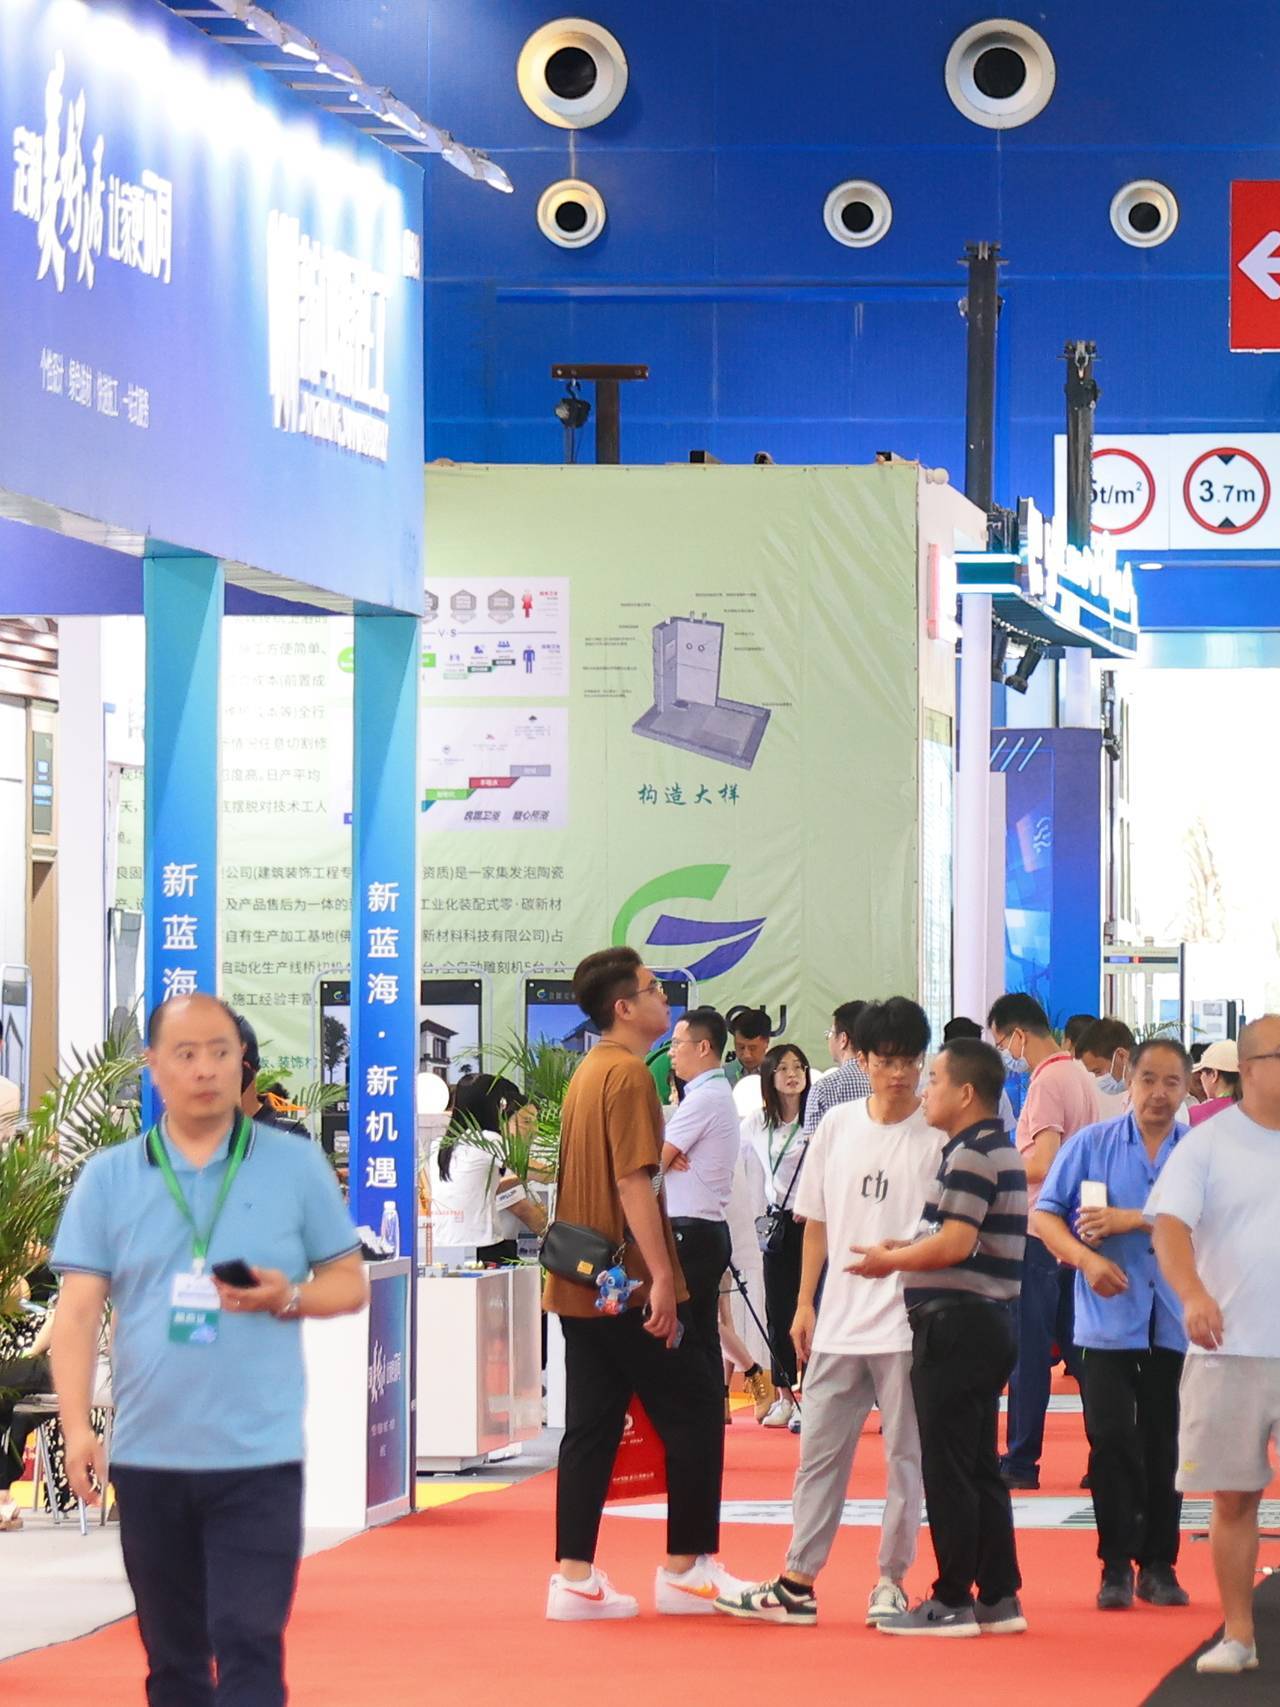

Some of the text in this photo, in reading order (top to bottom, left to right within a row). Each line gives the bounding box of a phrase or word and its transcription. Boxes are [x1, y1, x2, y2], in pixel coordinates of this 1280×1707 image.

[1199, 480, 1256, 503] 3.7m
[638, 783, 741, 805] 构造大样
[225, 897, 352, 911] 及产品售后为一体的
[162, 862, 200, 1003] 新蓝海
